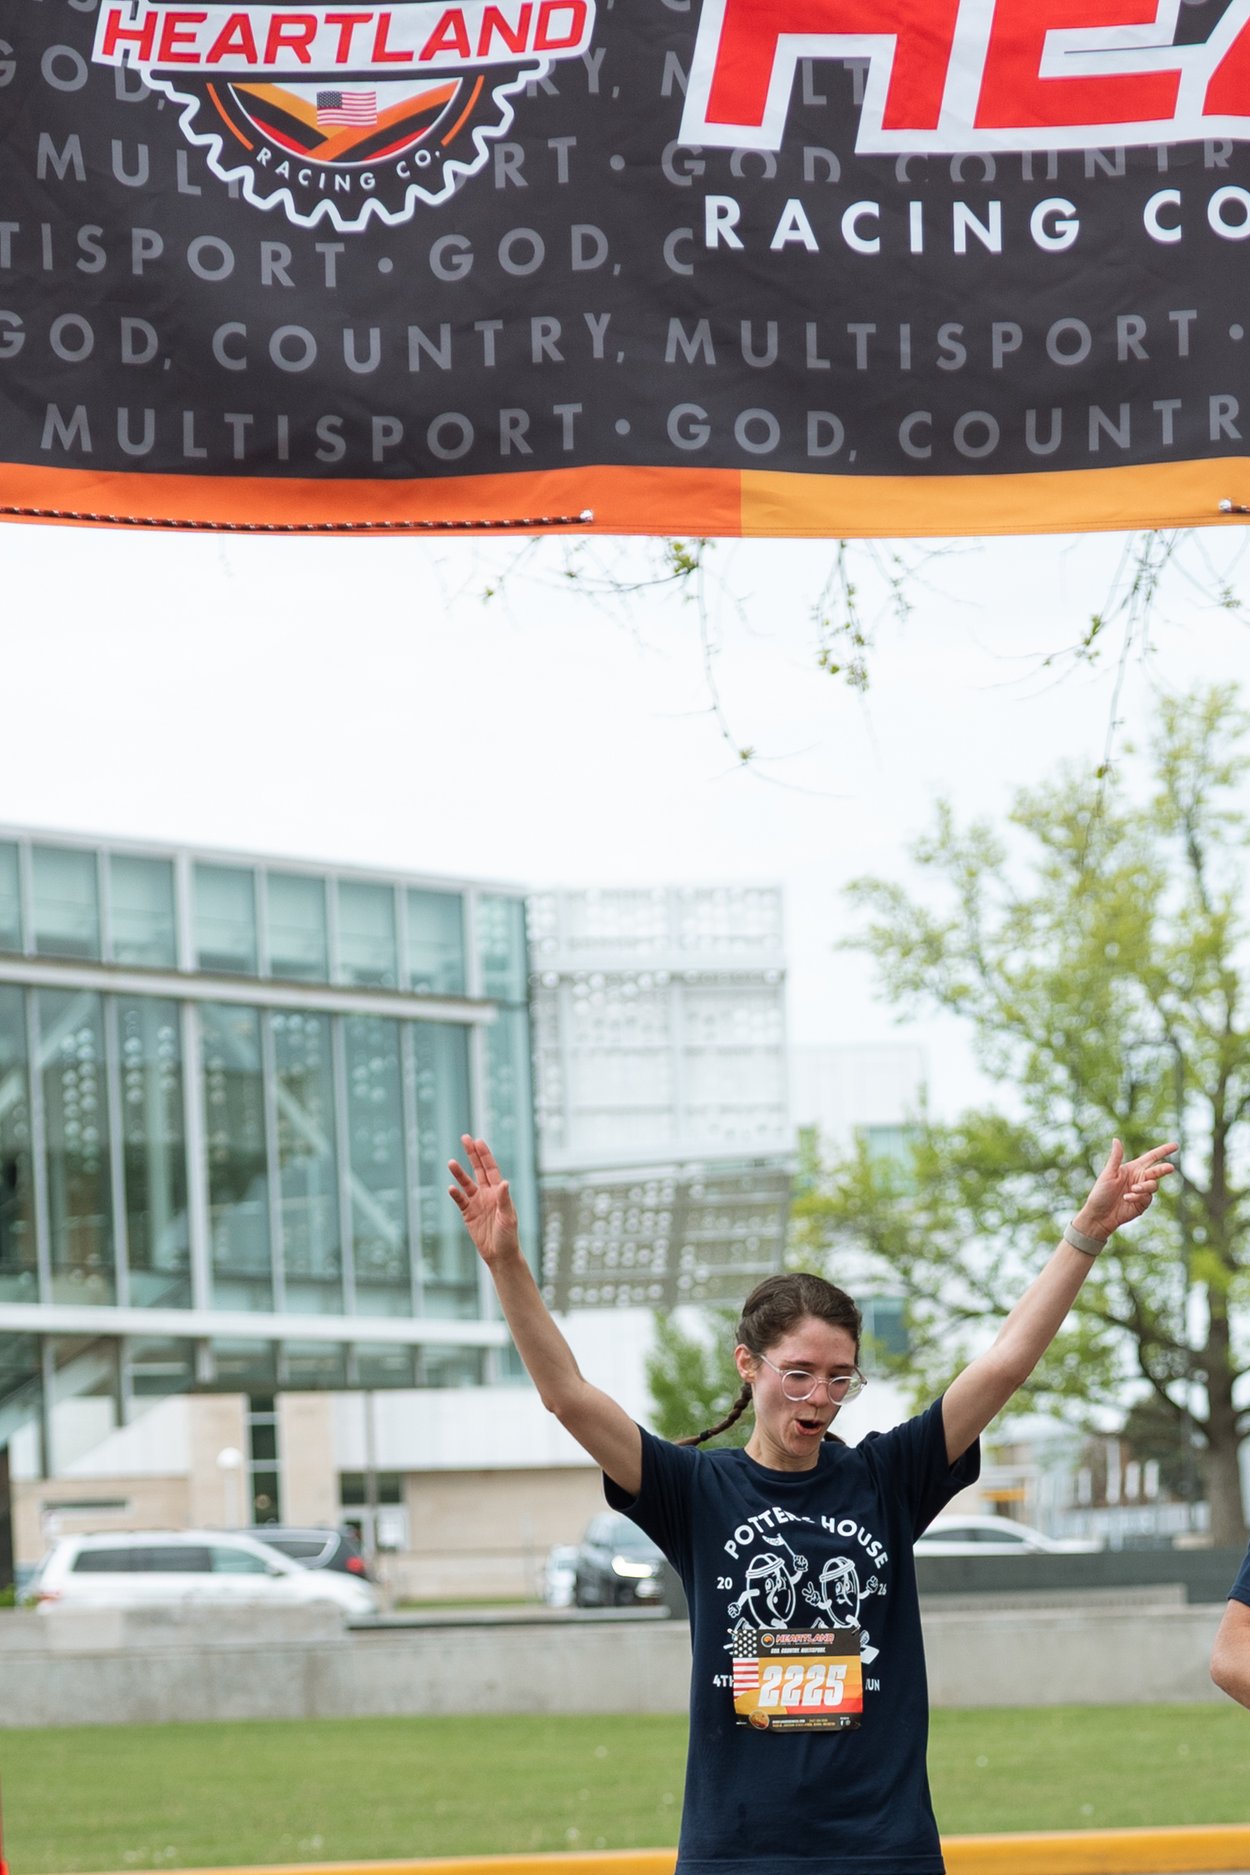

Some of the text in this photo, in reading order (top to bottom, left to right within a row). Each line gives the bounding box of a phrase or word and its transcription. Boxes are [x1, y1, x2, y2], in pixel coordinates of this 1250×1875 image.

[102, 0, 588, 64] HEARTLAND
[256, 147, 440, 192] RACING CO.
[429, 223, 622, 282] GOD,
[704, 194, 1080, 255] RACING
[212, 312, 625, 375] COUNTRY,
[665, 309, 1198, 370] MULTISPORT
[41, 402, 583, 462] MULTISPORT
[667, 402, 857, 463] GOD,
[821, 1515, 888, 1569] HOUSE
[716, 1576, 733, 1590] 20
[758, 1664, 847, 1706] 2225
